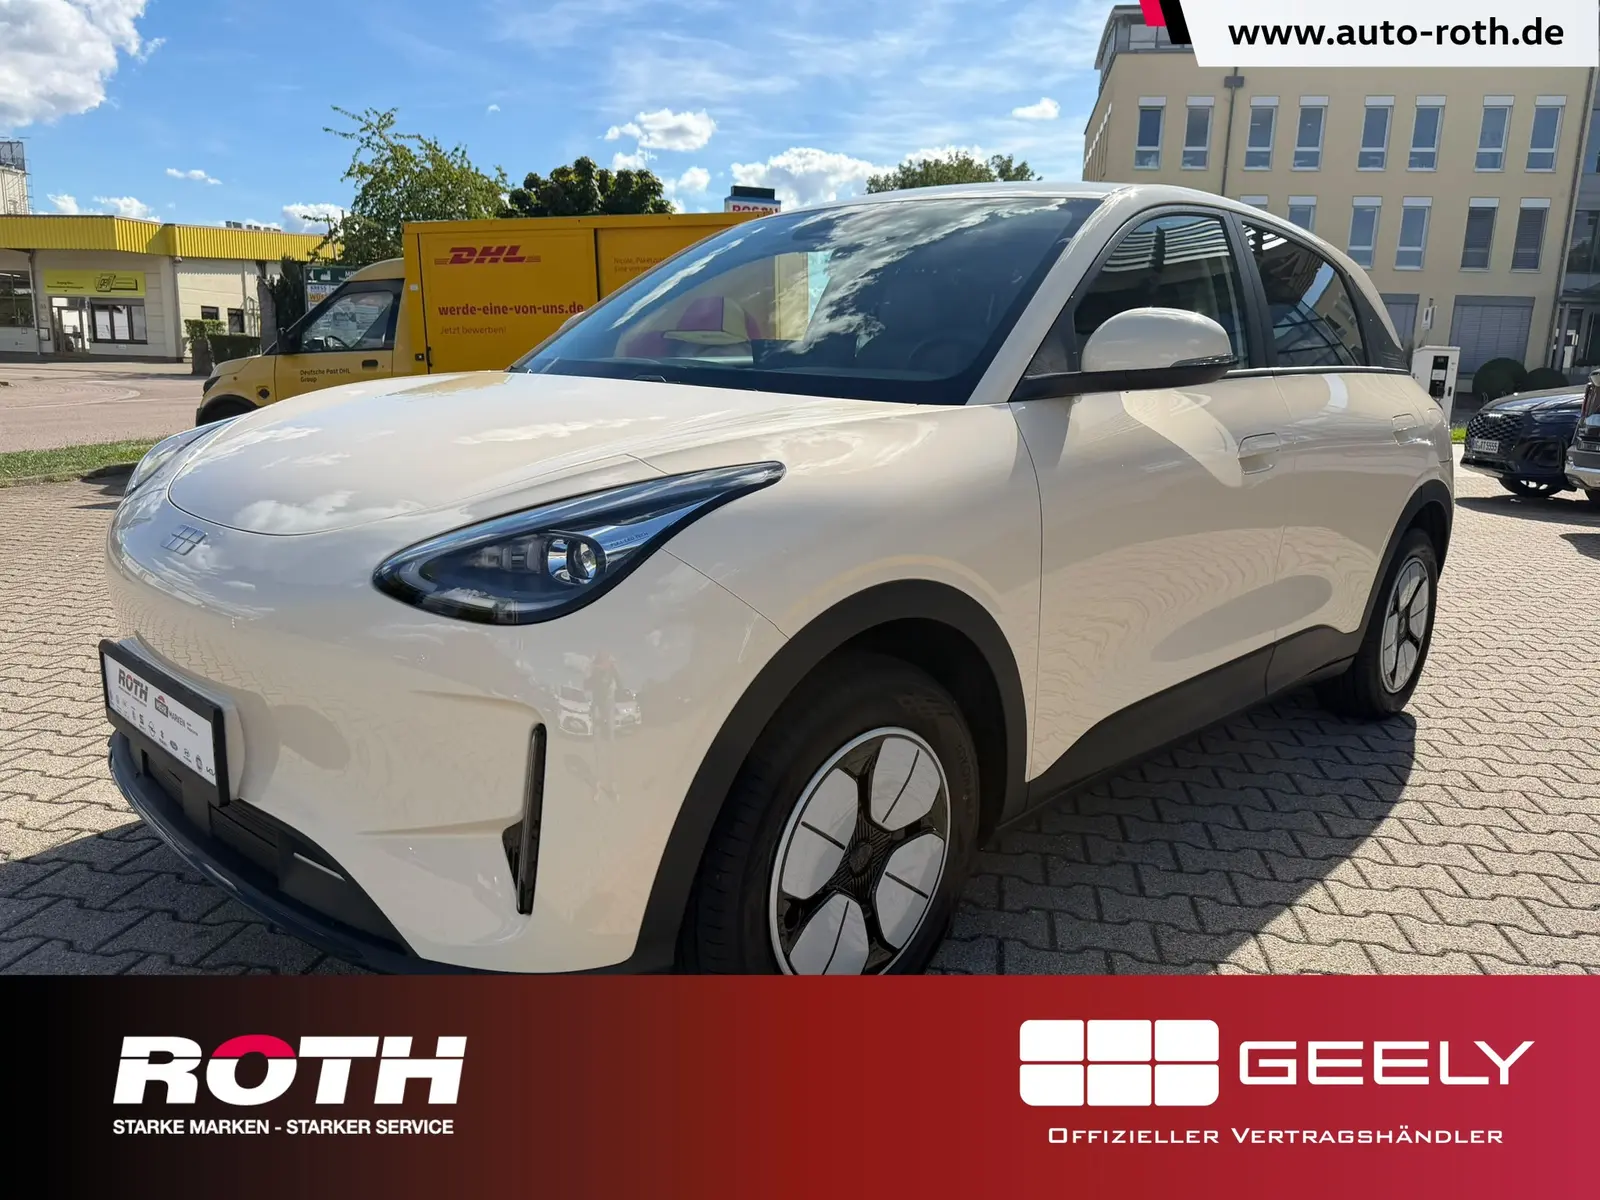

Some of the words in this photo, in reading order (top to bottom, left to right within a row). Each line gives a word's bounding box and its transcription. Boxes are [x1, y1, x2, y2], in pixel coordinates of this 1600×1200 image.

[449, 245, 526, 264] DHL
[438, 301, 584, 316] werde-eine-von-uns.de
[440, 326, 460, 335] Jetzt
[300, 376, 317, 384] Group
[118, 668, 149, 703] ROTH
